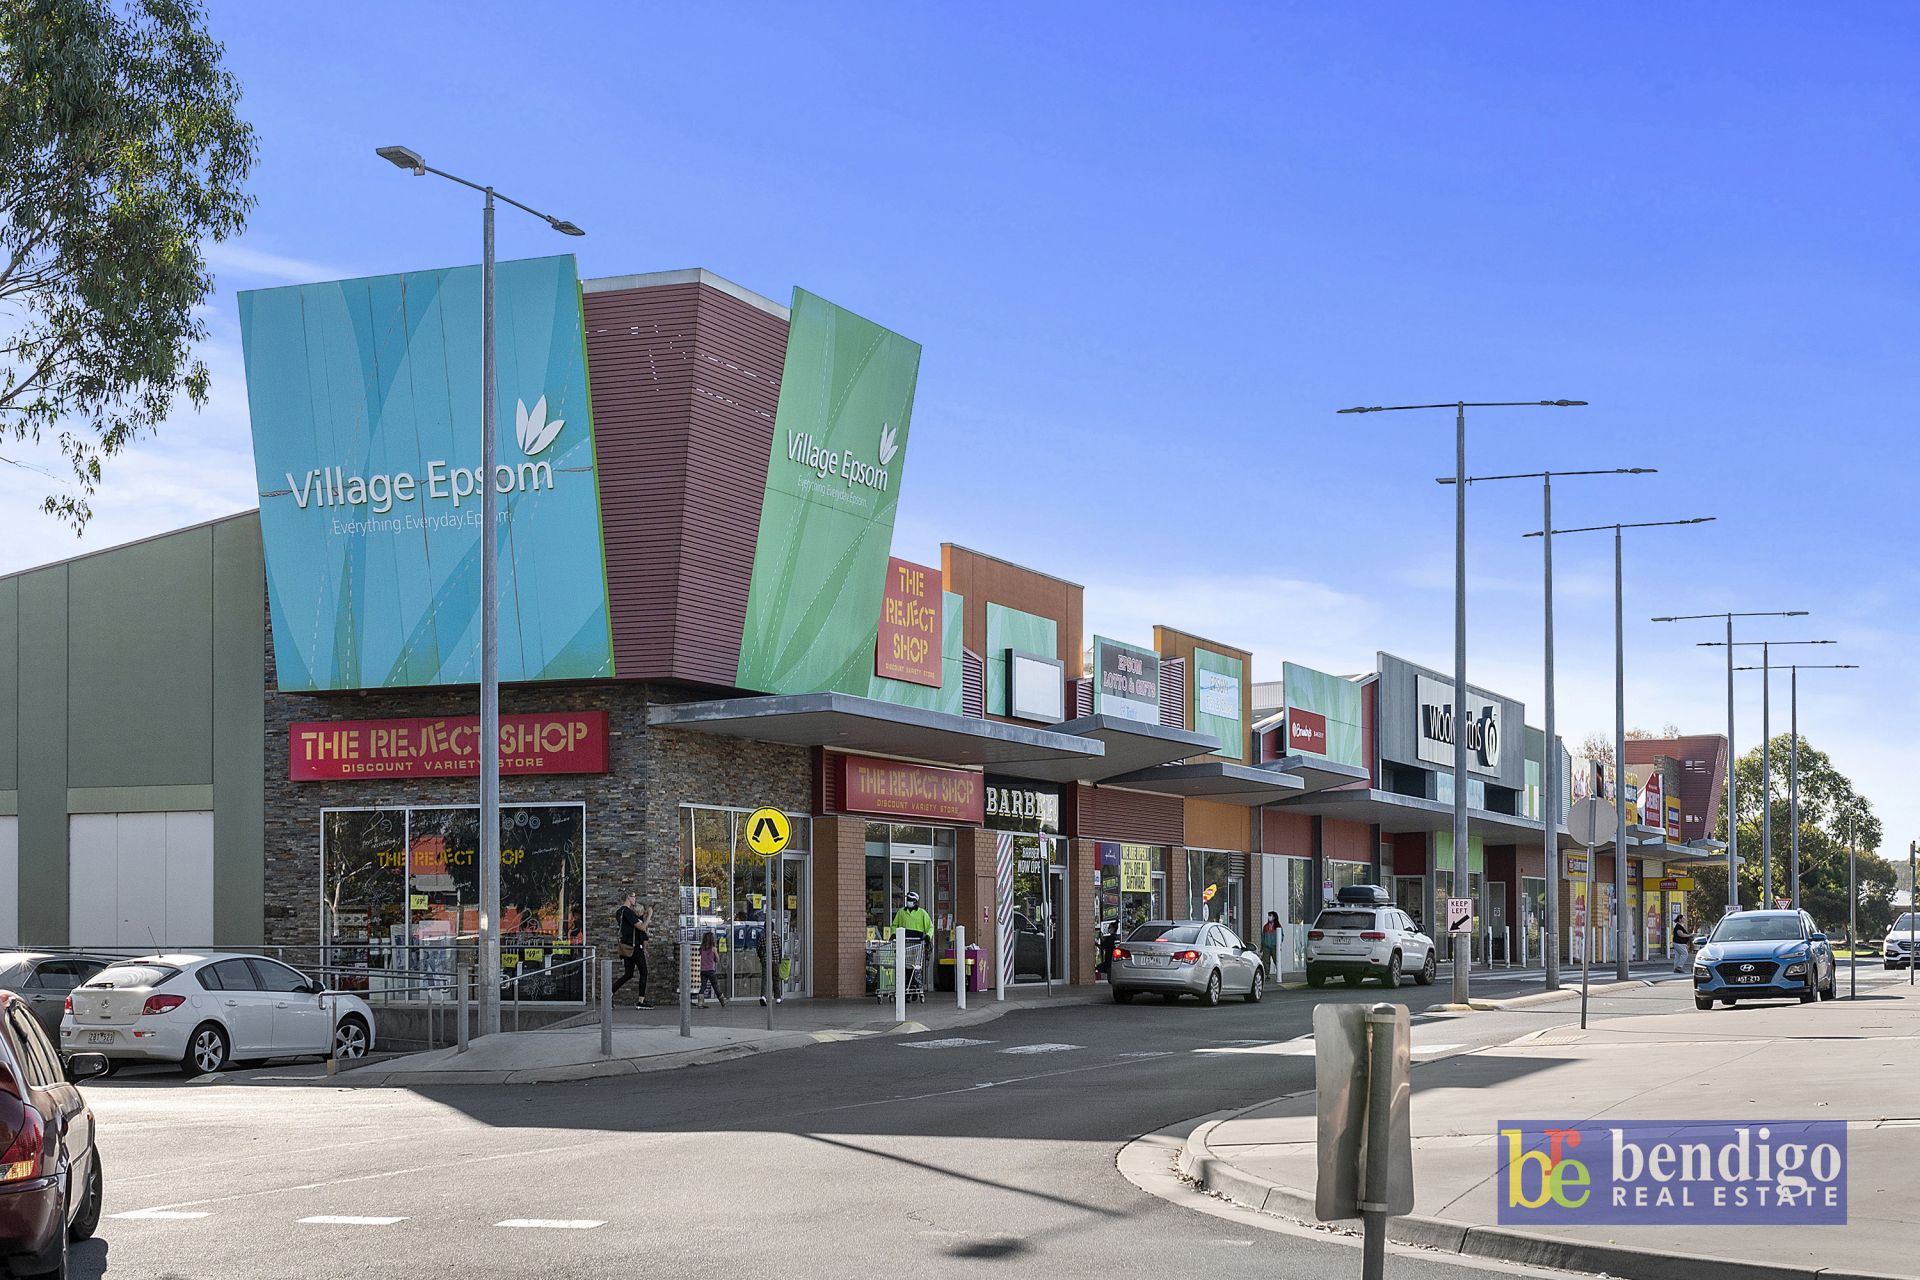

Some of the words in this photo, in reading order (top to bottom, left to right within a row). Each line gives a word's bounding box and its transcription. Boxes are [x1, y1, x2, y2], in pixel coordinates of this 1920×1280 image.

[787, 429, 838, 479] Village
[841, 449, 888, 492] Epsom
[286, 466, 415, 513] Village
[427, 460, 554, 507] Epsom
[333, 510, 516, 537] Everything.Everyday.Epm.
[898, 566, 924, 597] THE
[886, 597, 936, 633] REJECT
[893, 632, 929, 664] SHOP
[1117, 654, 1143, 675] EPSOM
[1103, 670, 1128, 692] LOTTO
[1135, 678, 1156, 698] GIFTS
[301, 731, 359, 761] THE
[500, 722, 588, 754] SHOP
[1423, 704, 1482, 751] Woolrths
[342, 762, 414, 773] DISCOUNT
[498, 758, 544, 768] STORE
[858, 767, 886, 796] THE
[889, 768, 939, 800] REJECT
[941, 777, 975, 804] SHOP
[876, 799, 908, 809] DISCOUNT
[911, 803, 937, 812] VARIETY
[986, 787, 1057, 821] BARBER
[377, 851, 406, 867] THE
[415, 848, 474, 866] REJECT
[499, 849, 525, 865] OP
[1018, 860, 1030, 874] NOW
[1031, 860, 1041, 874] OPE
